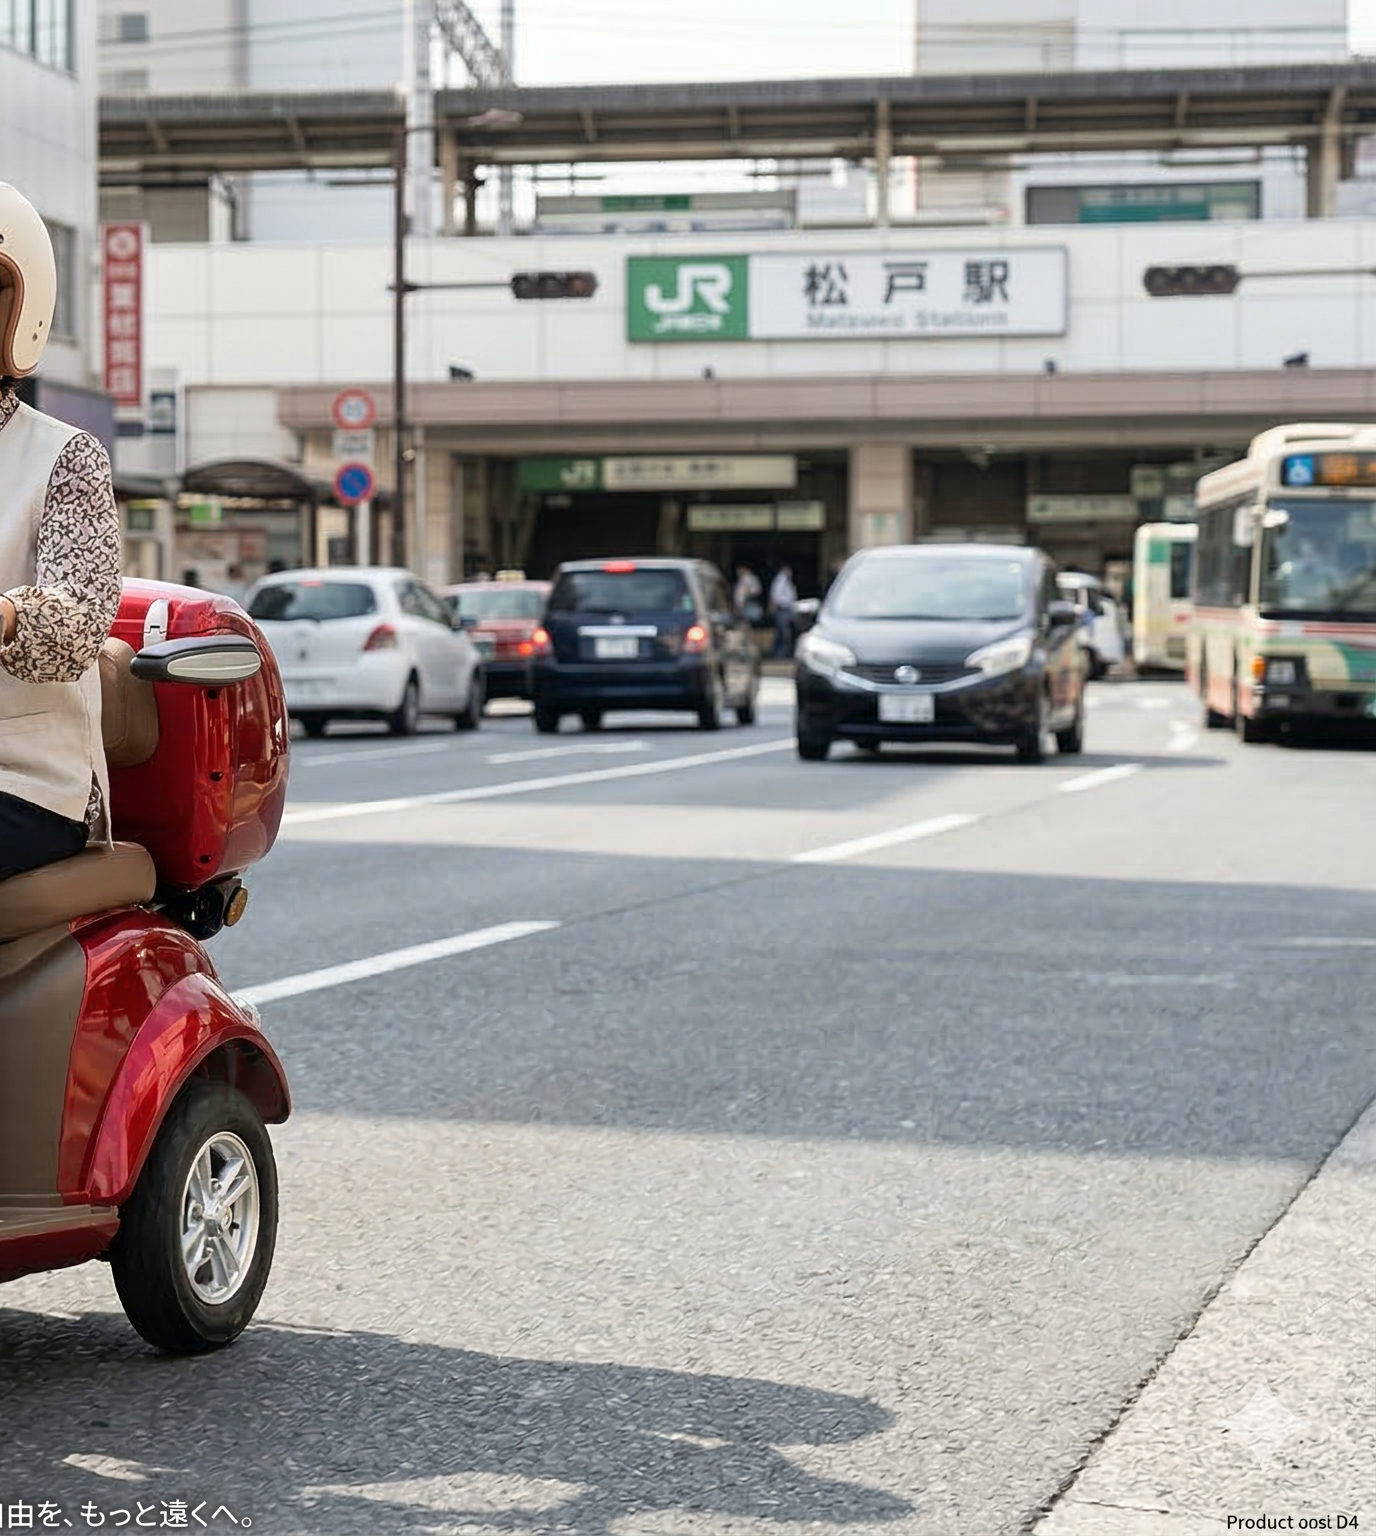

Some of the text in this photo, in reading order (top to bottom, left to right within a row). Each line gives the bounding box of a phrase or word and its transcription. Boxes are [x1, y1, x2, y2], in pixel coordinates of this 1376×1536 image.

[645, 264, 732, 313] JR
[803, 261, 1010, 305] 松戸駅
